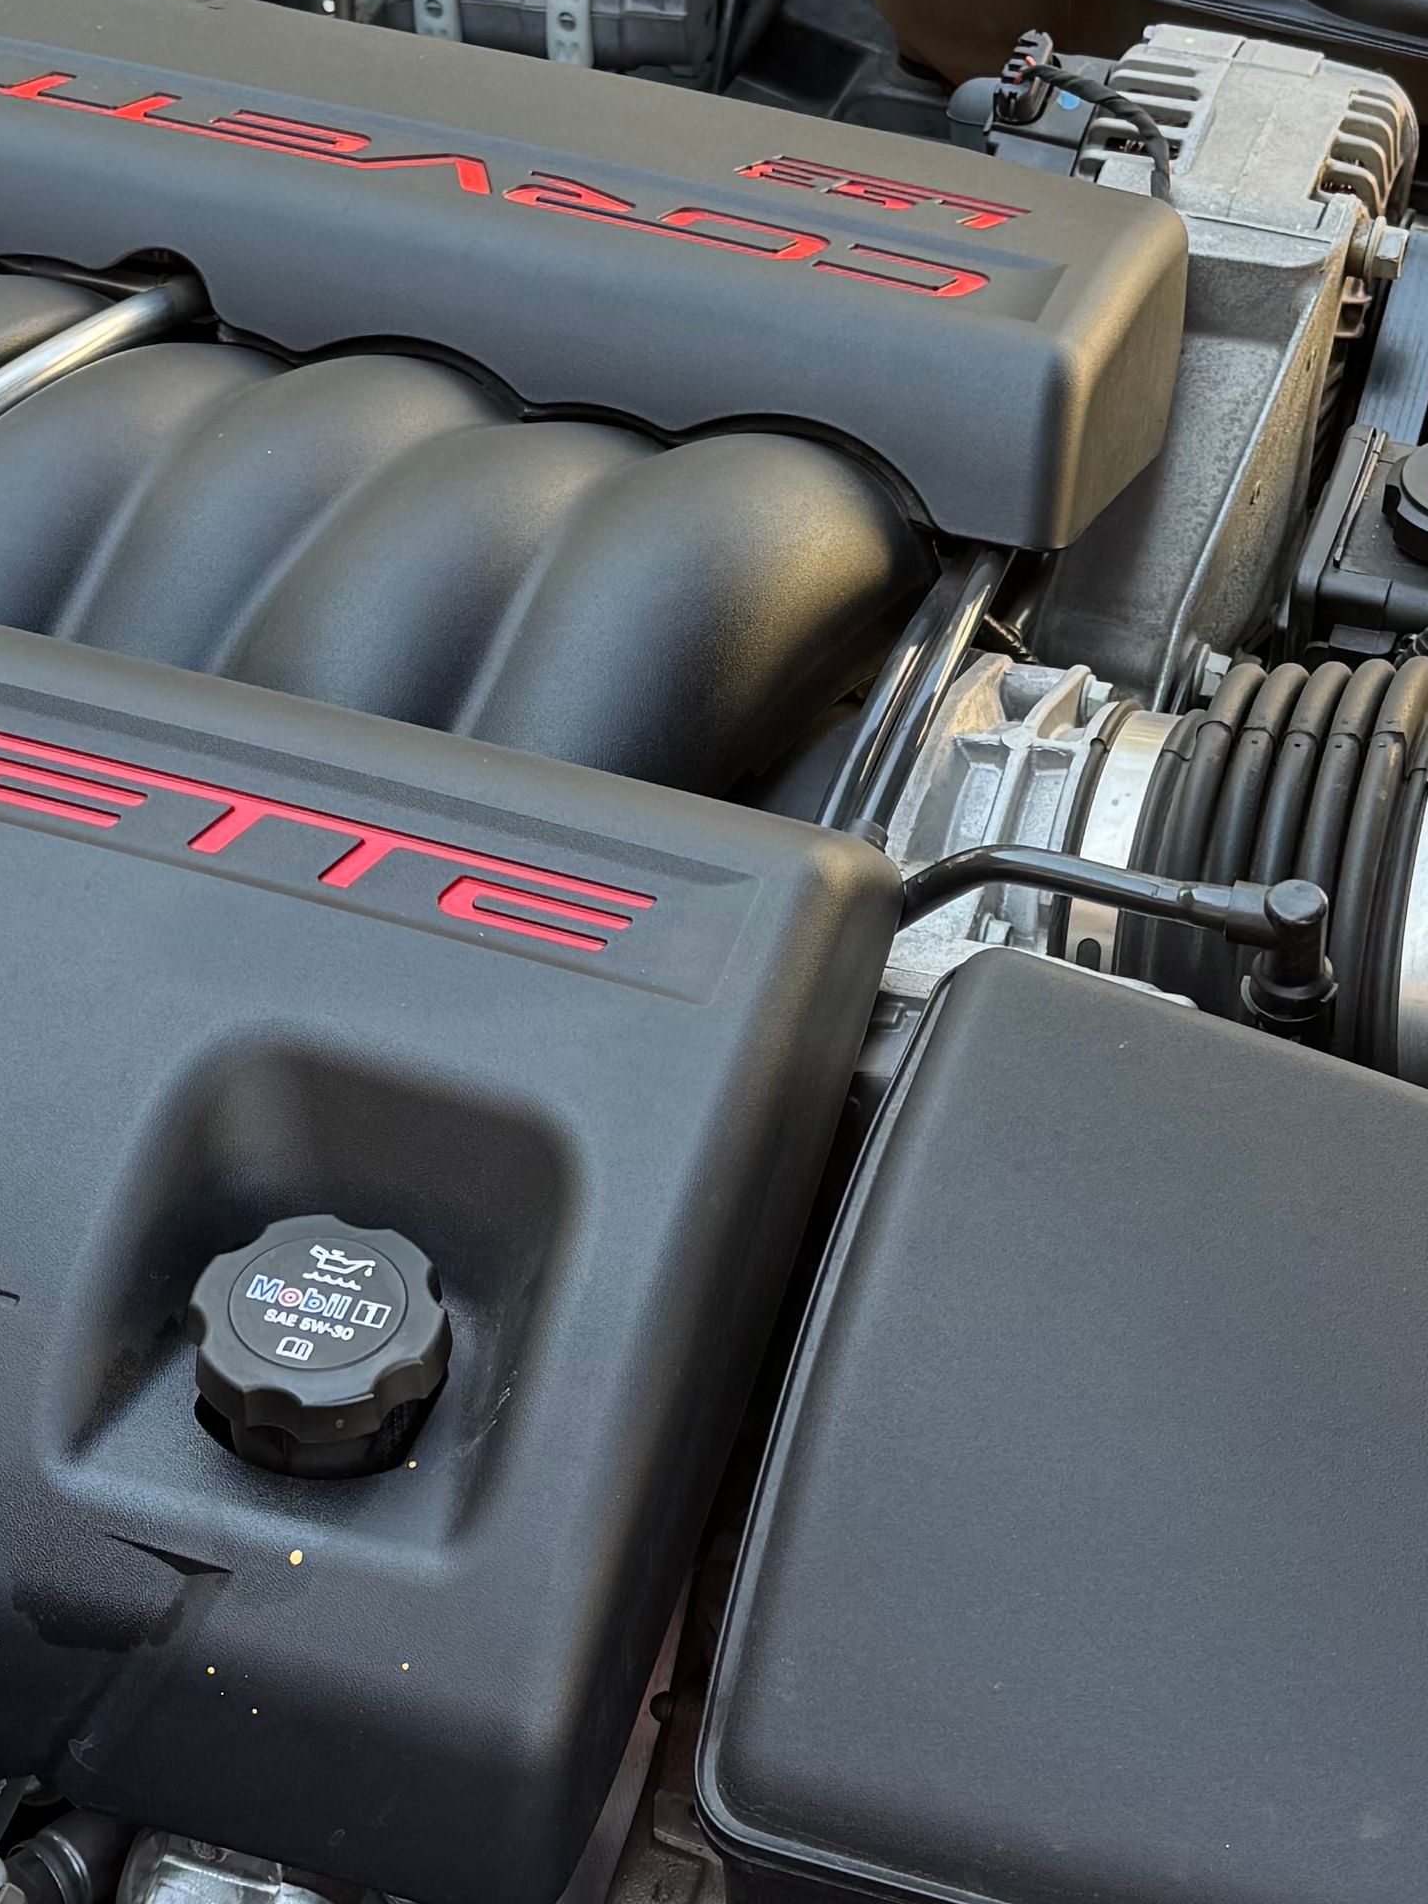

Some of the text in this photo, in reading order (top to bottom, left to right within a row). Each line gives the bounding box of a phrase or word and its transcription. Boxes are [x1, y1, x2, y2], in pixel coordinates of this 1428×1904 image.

[734, 156, 1027, 230] LS3
[246, 1274, 353, 1320] Mobil
[264, 1309, 355, 1341] SAE 5W-30
